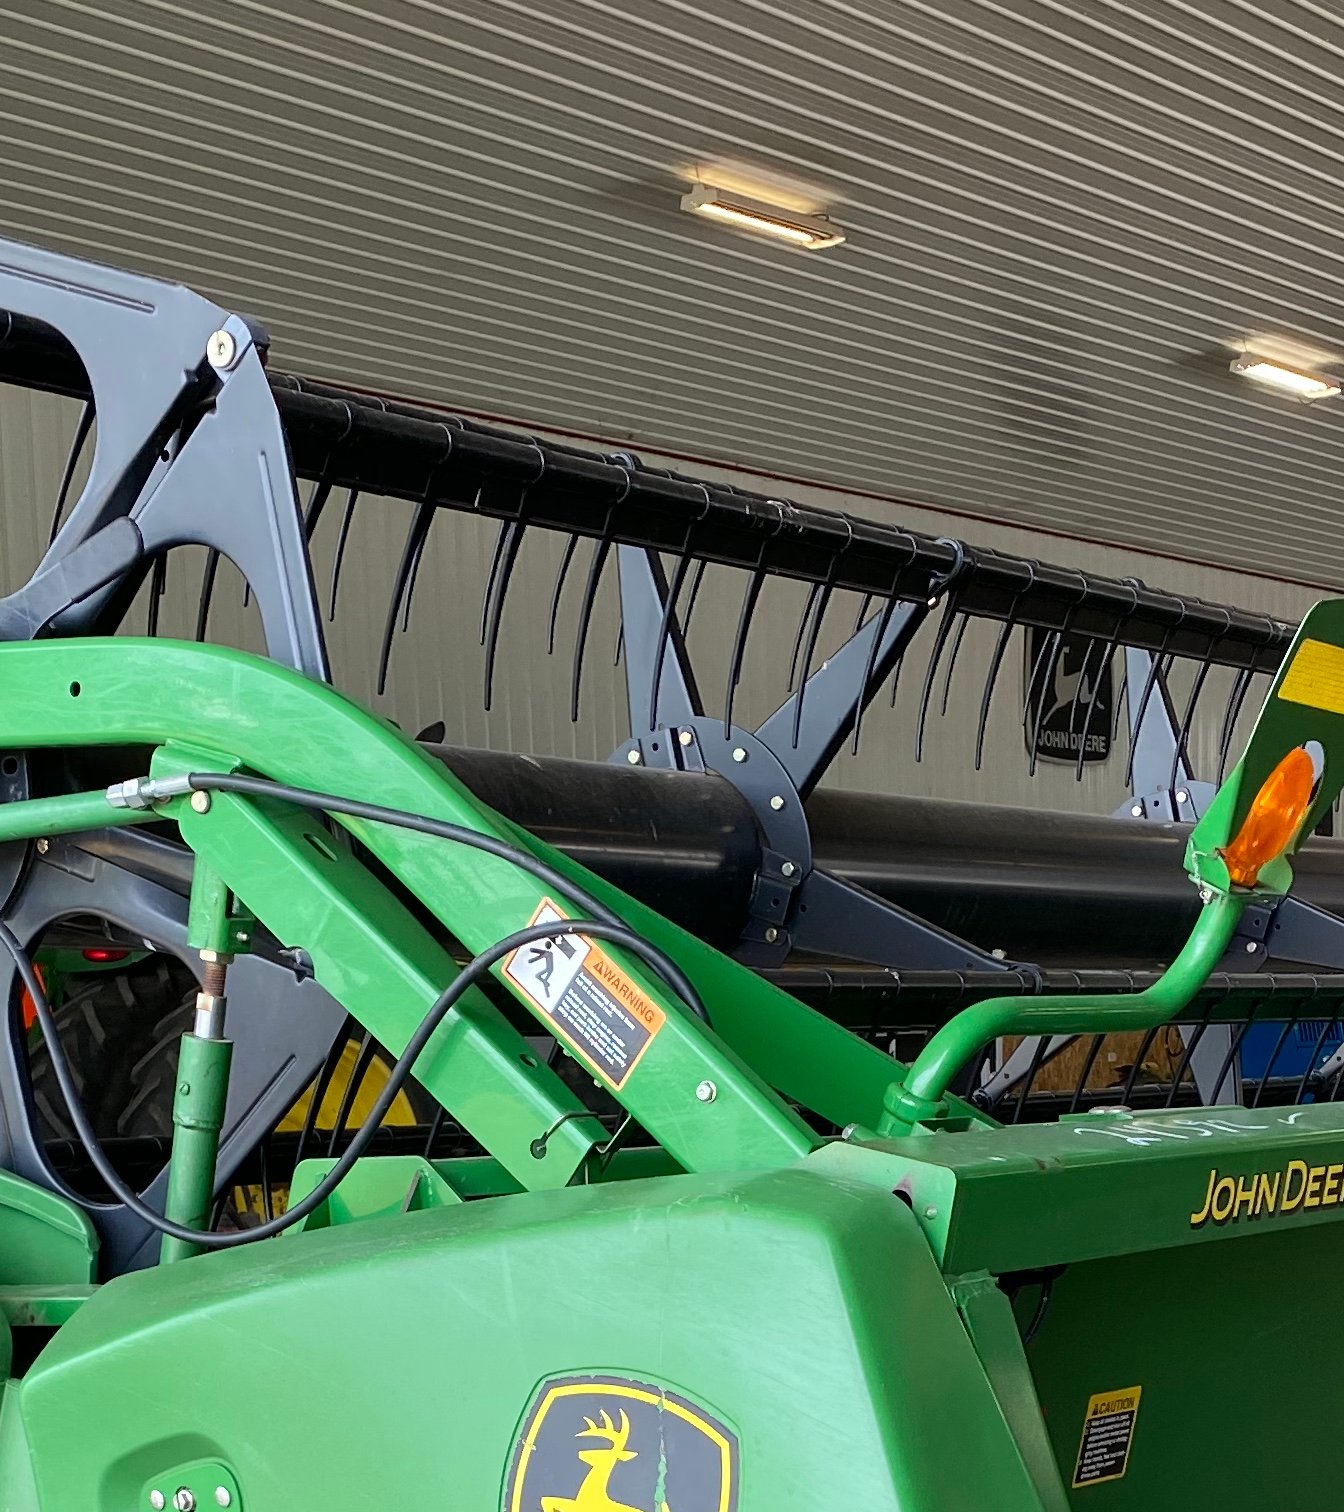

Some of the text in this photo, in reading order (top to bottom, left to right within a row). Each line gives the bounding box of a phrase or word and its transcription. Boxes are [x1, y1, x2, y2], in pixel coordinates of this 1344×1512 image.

[1038, 729, 1069, 749] JOHN
[602, 965, 655, 1024] WARNING
[1190, 1168, 1280, 1228] JOHN
[1099, 1397, 1136, 1413] CAUTION
